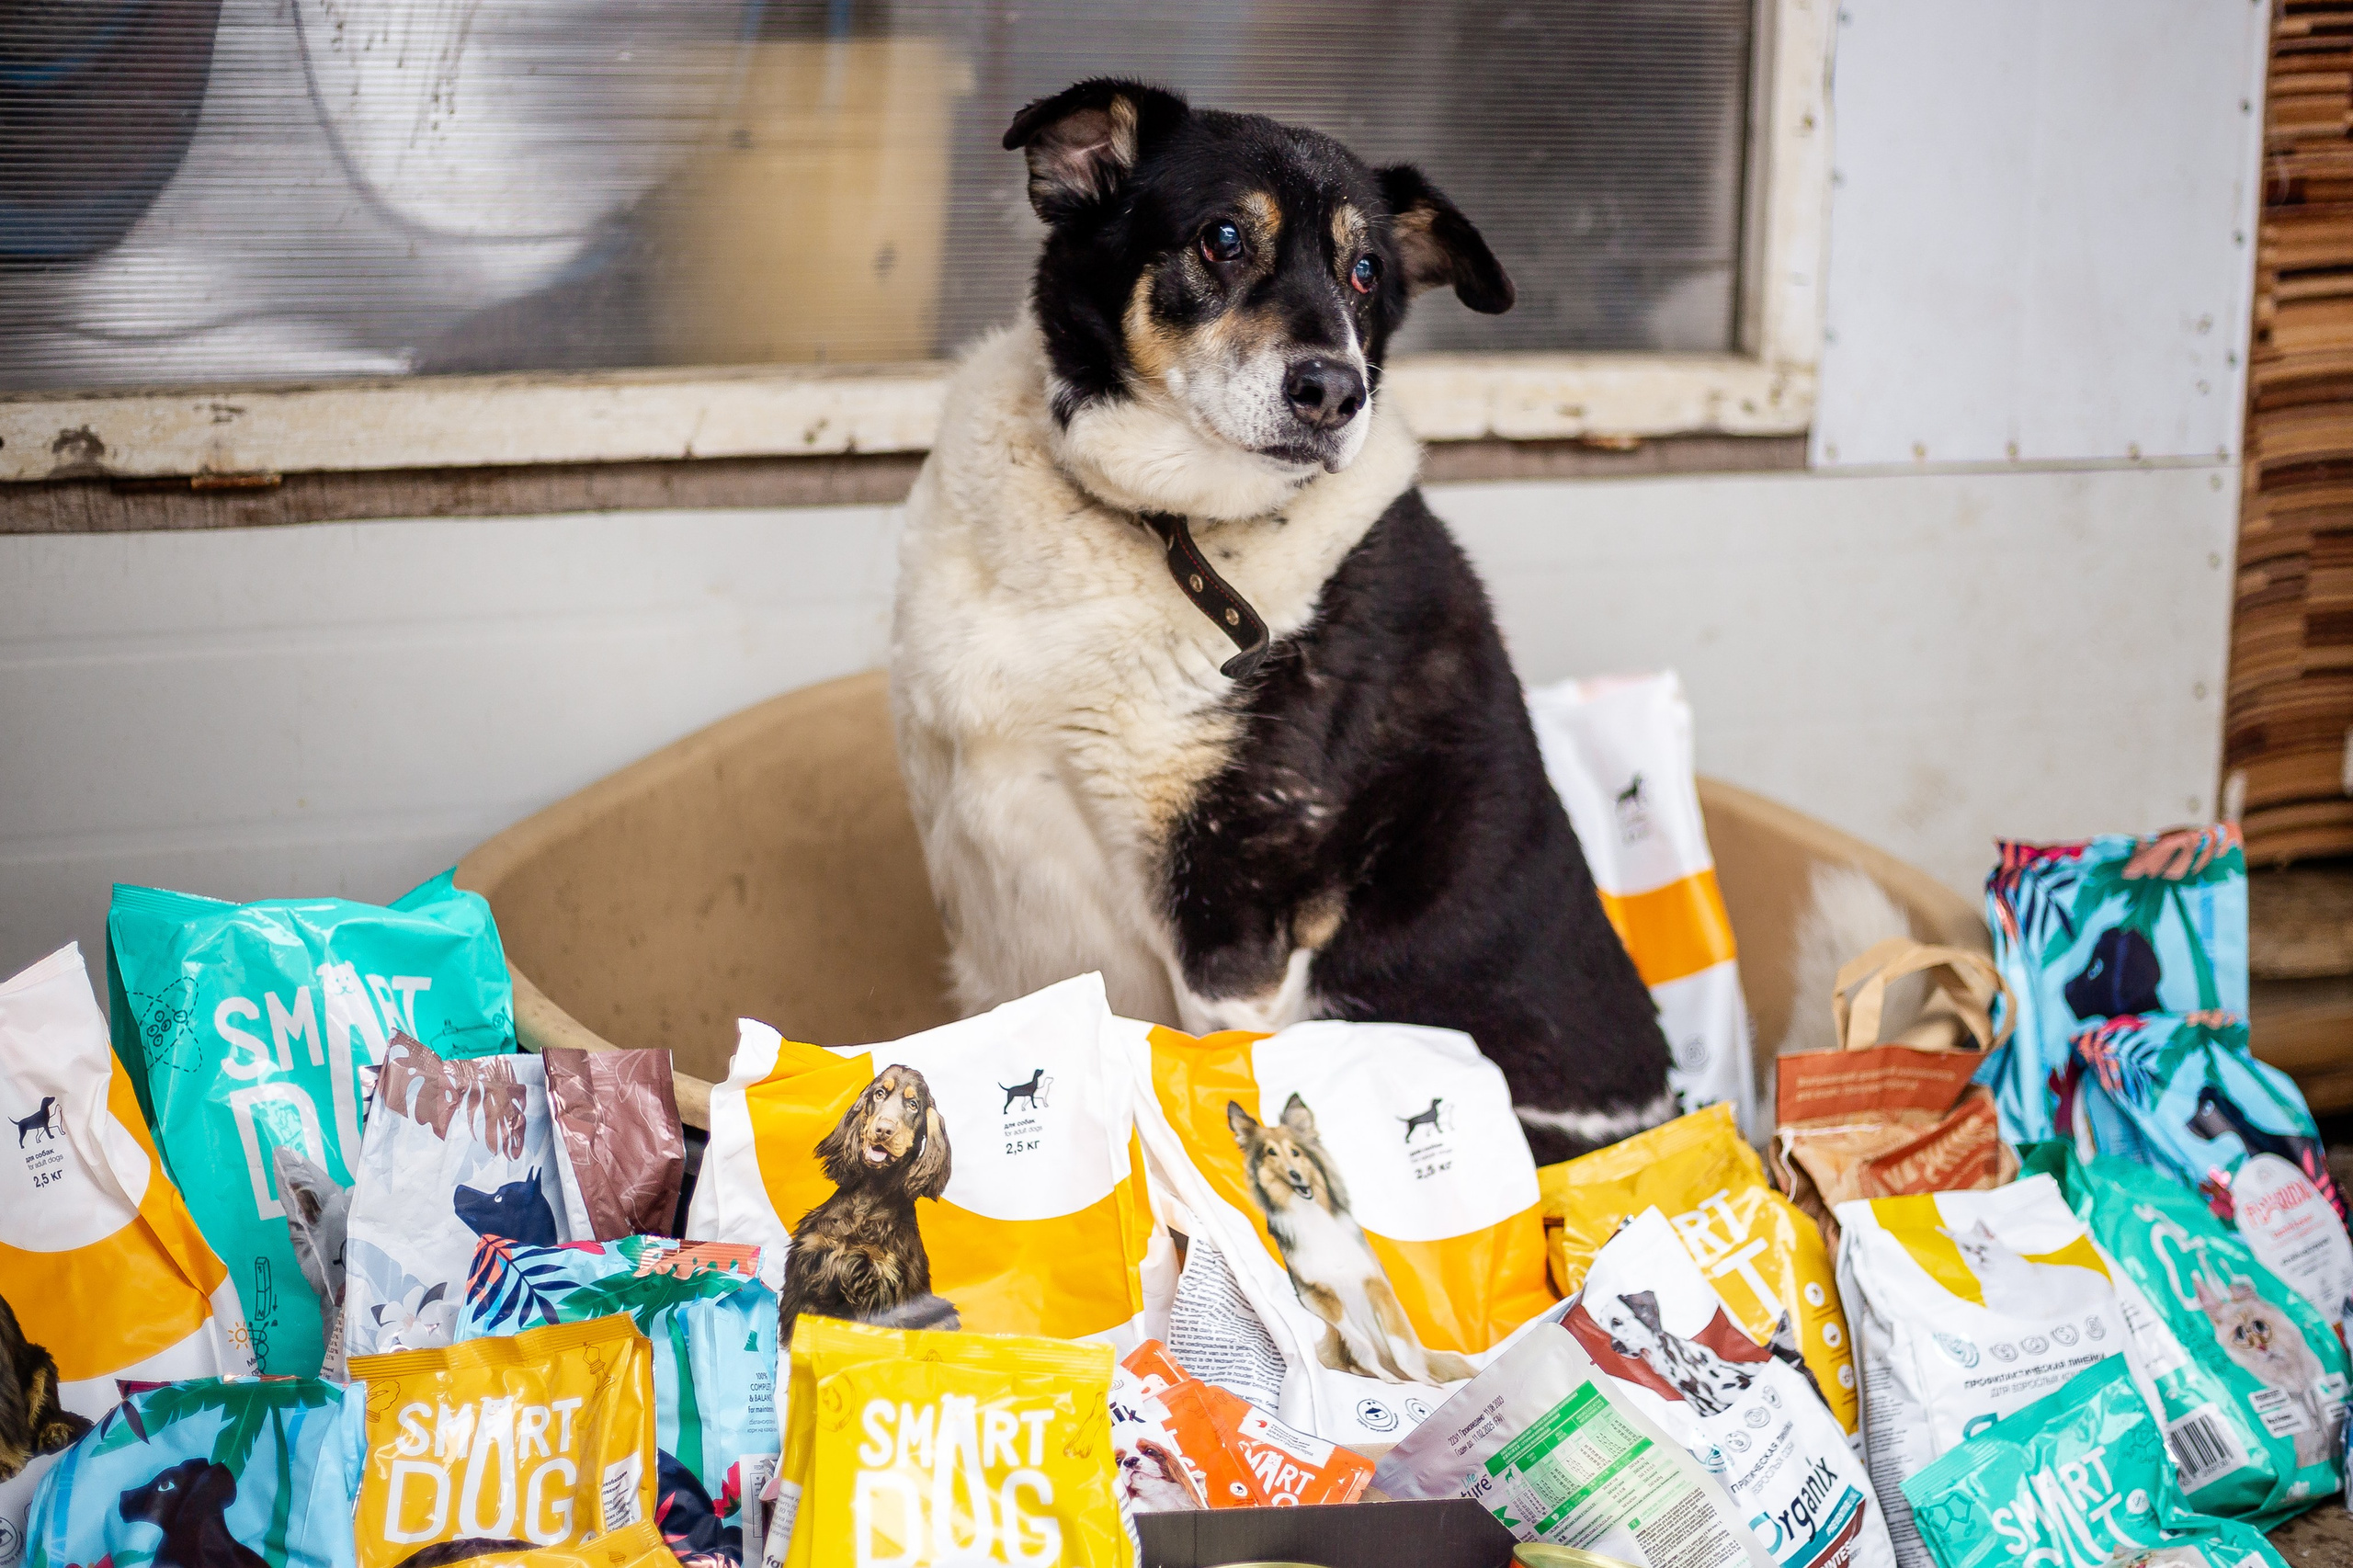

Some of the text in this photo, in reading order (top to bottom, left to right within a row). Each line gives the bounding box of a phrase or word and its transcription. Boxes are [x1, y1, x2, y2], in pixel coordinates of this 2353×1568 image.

[214, 960, 432, 1081] SMART
[26, 1148, 54, 1164] для собак
[33, 1173, 50, 1187] 2,5
[35, 1159, 47, 1168] adult
[48, 1153, 63, 1163] dogs
[1006, 1141, 1023, 1155] 2,5
[395, 1395, 582, 1460] SMART
[859, 1393, 1055, 1469] SMART
[1472, 1421, 1495, 1443] 11.02.2025
[1482, 1394, 1505, 1416] 11.08.2023
[384, 1458, 577, 1546] DOG
[855, 1468, 1063, 1568] DOG
[1748, 1457, 1838, 1557] Organix
[1992, 1446, 2114, 1557] SMART
